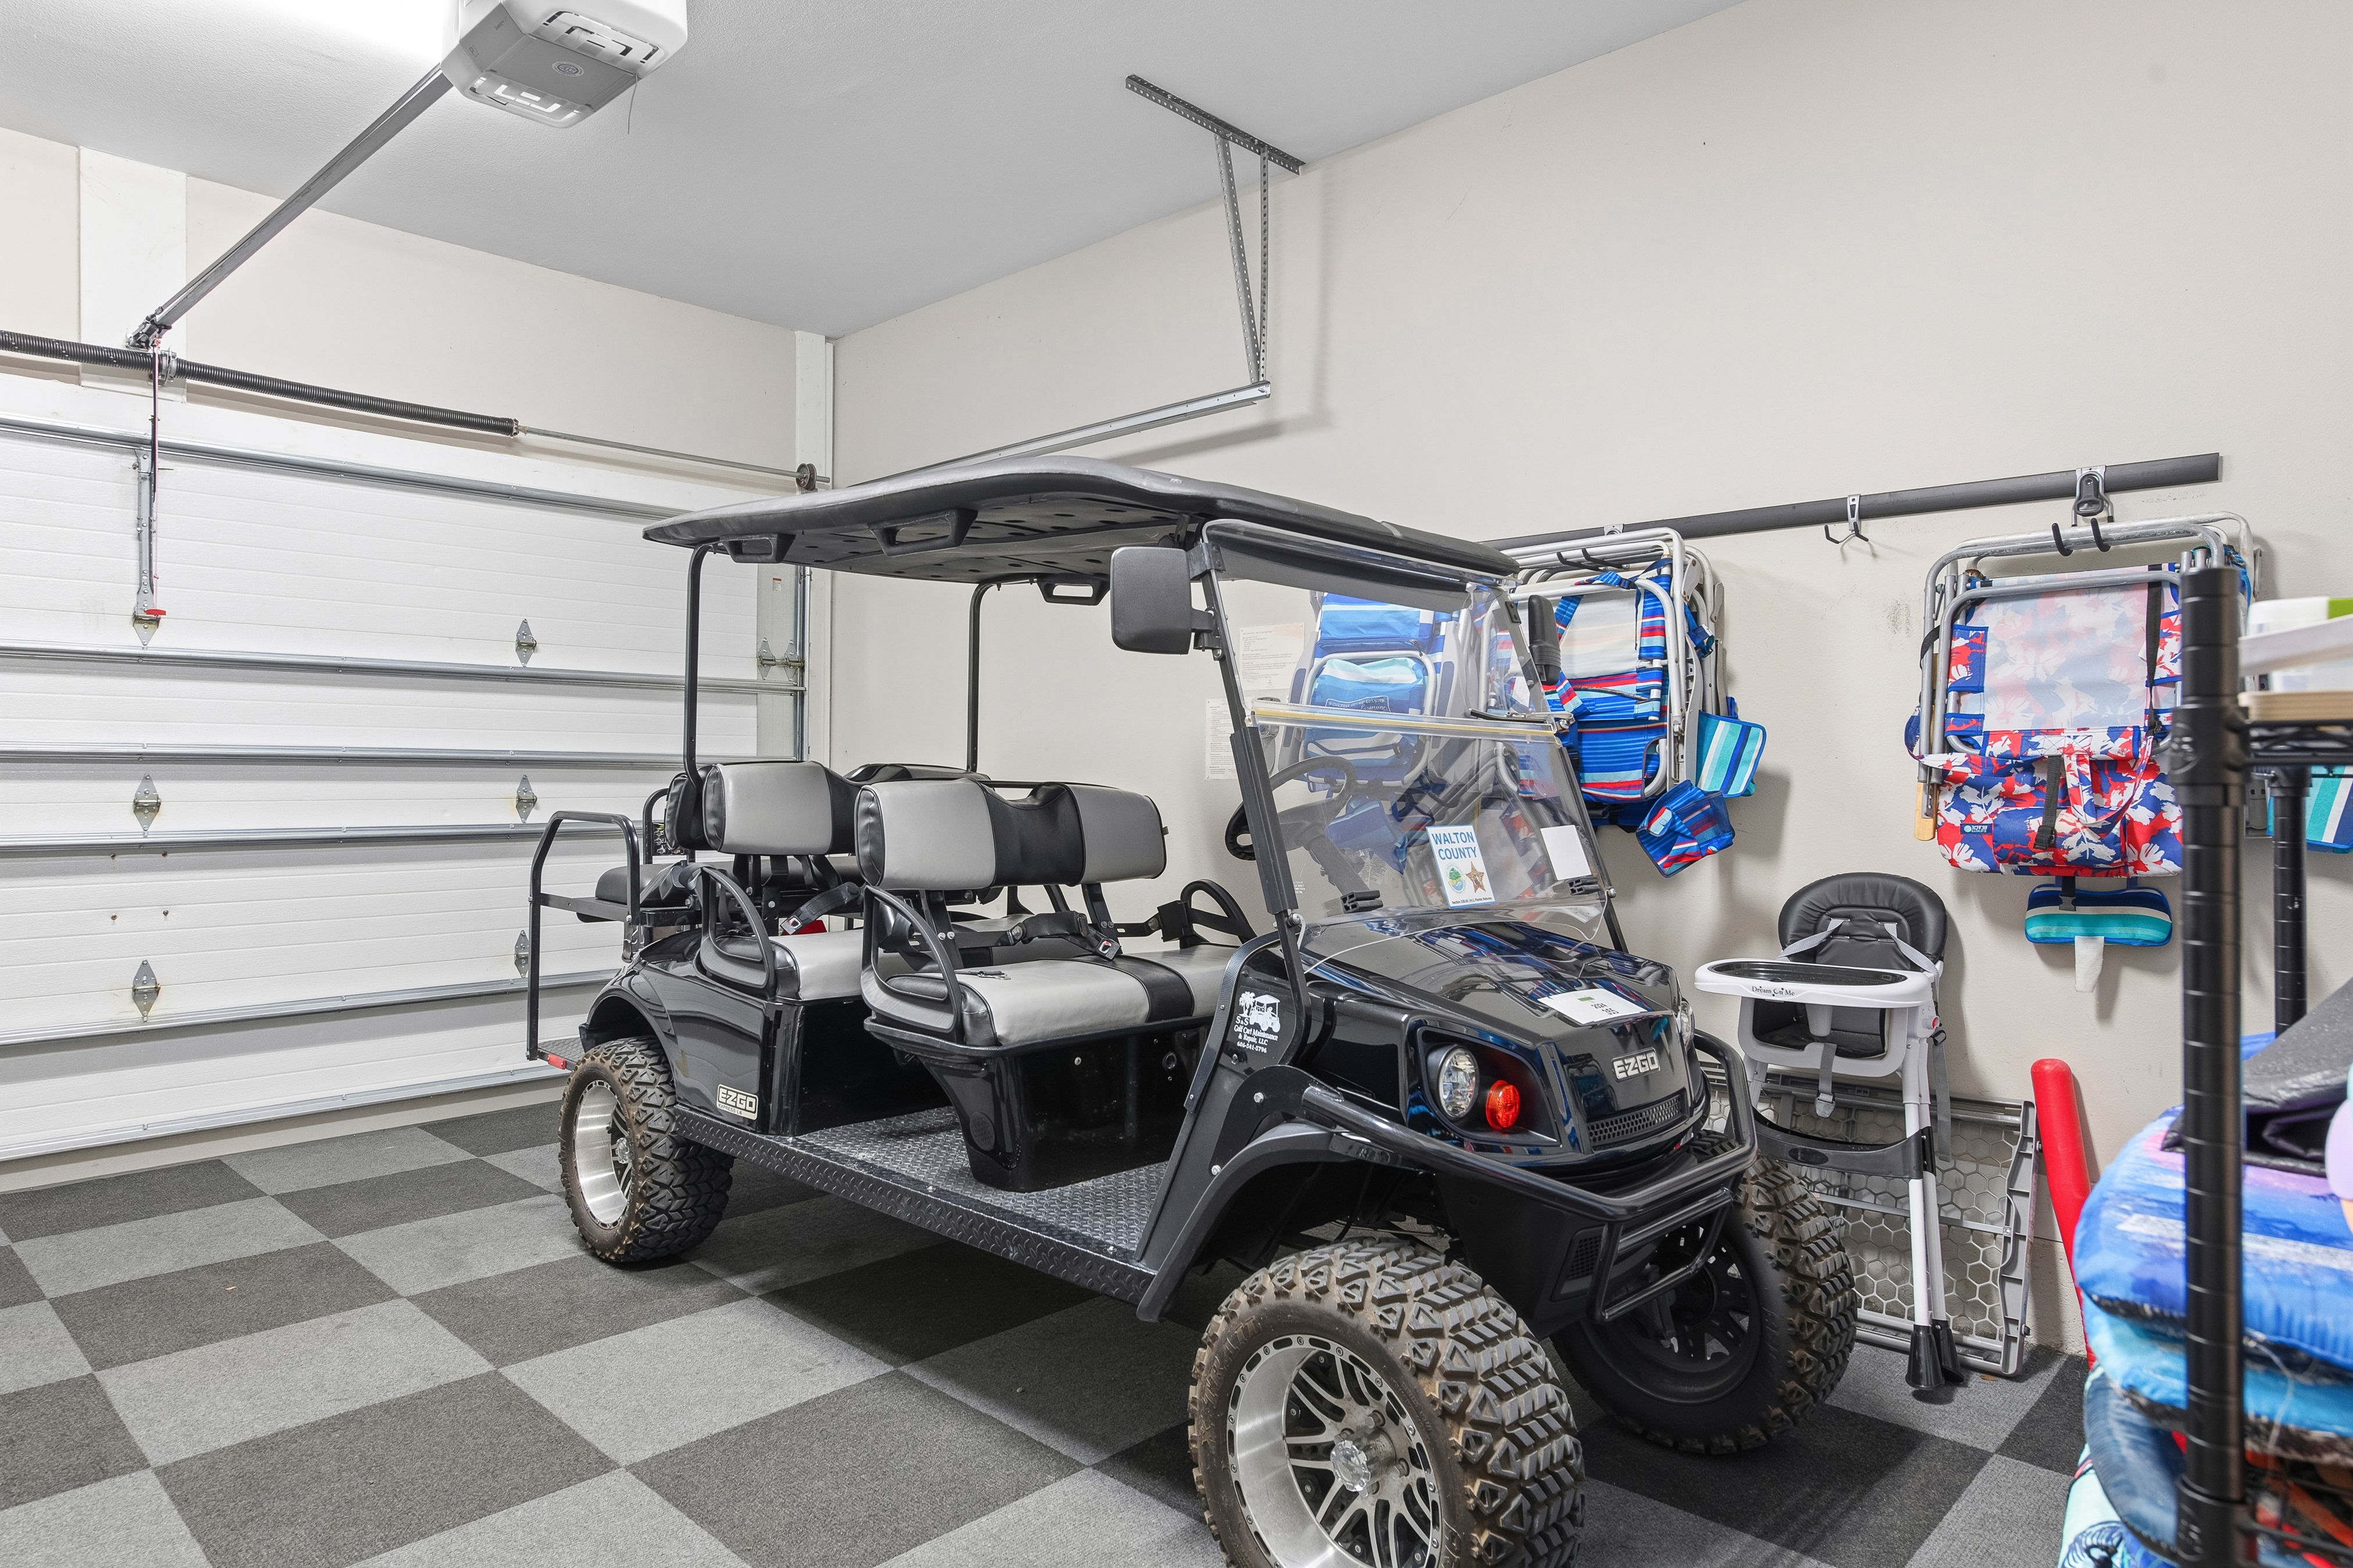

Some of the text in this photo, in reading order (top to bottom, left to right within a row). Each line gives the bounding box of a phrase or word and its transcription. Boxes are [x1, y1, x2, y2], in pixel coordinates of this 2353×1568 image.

[1432, 831, 1475, 845] WALTON
[1438, 846, 1477, 860] COUNTY
[1243, 1034, 1257, 1044] Repair,
[1258, 1038, 1268, 1046] LLC
[1252, 1029, 1278, 1041] Maintenance
[718, 1103, 736, 1113] EXPRESS
